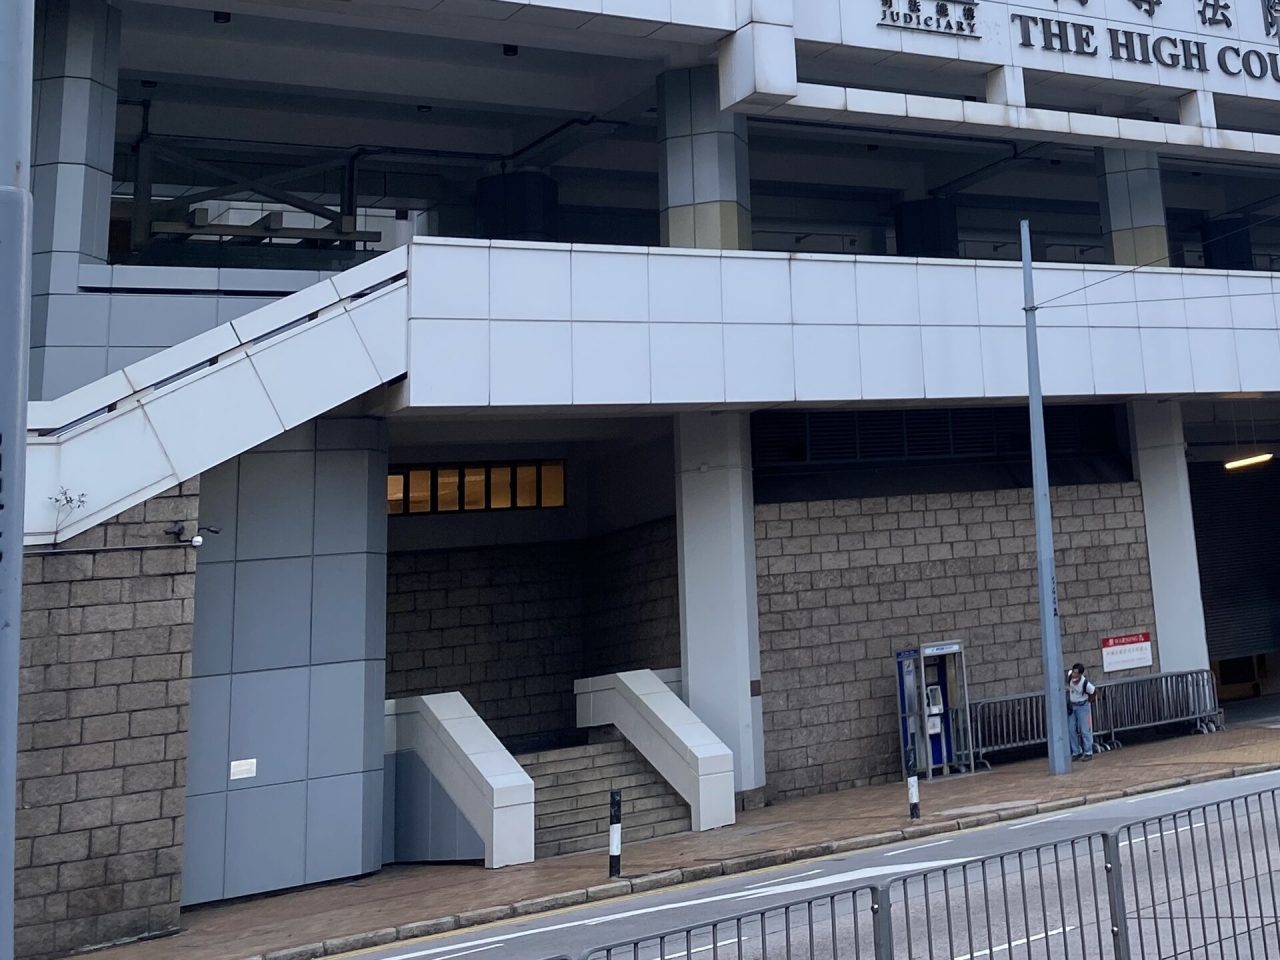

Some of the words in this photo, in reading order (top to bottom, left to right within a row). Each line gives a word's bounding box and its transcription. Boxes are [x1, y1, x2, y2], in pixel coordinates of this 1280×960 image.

[881, 10, 976, 33] JUDICIARY
[1011, 13, 1099, 57] THE
[1107, 28, 1210, 72] HIGH
